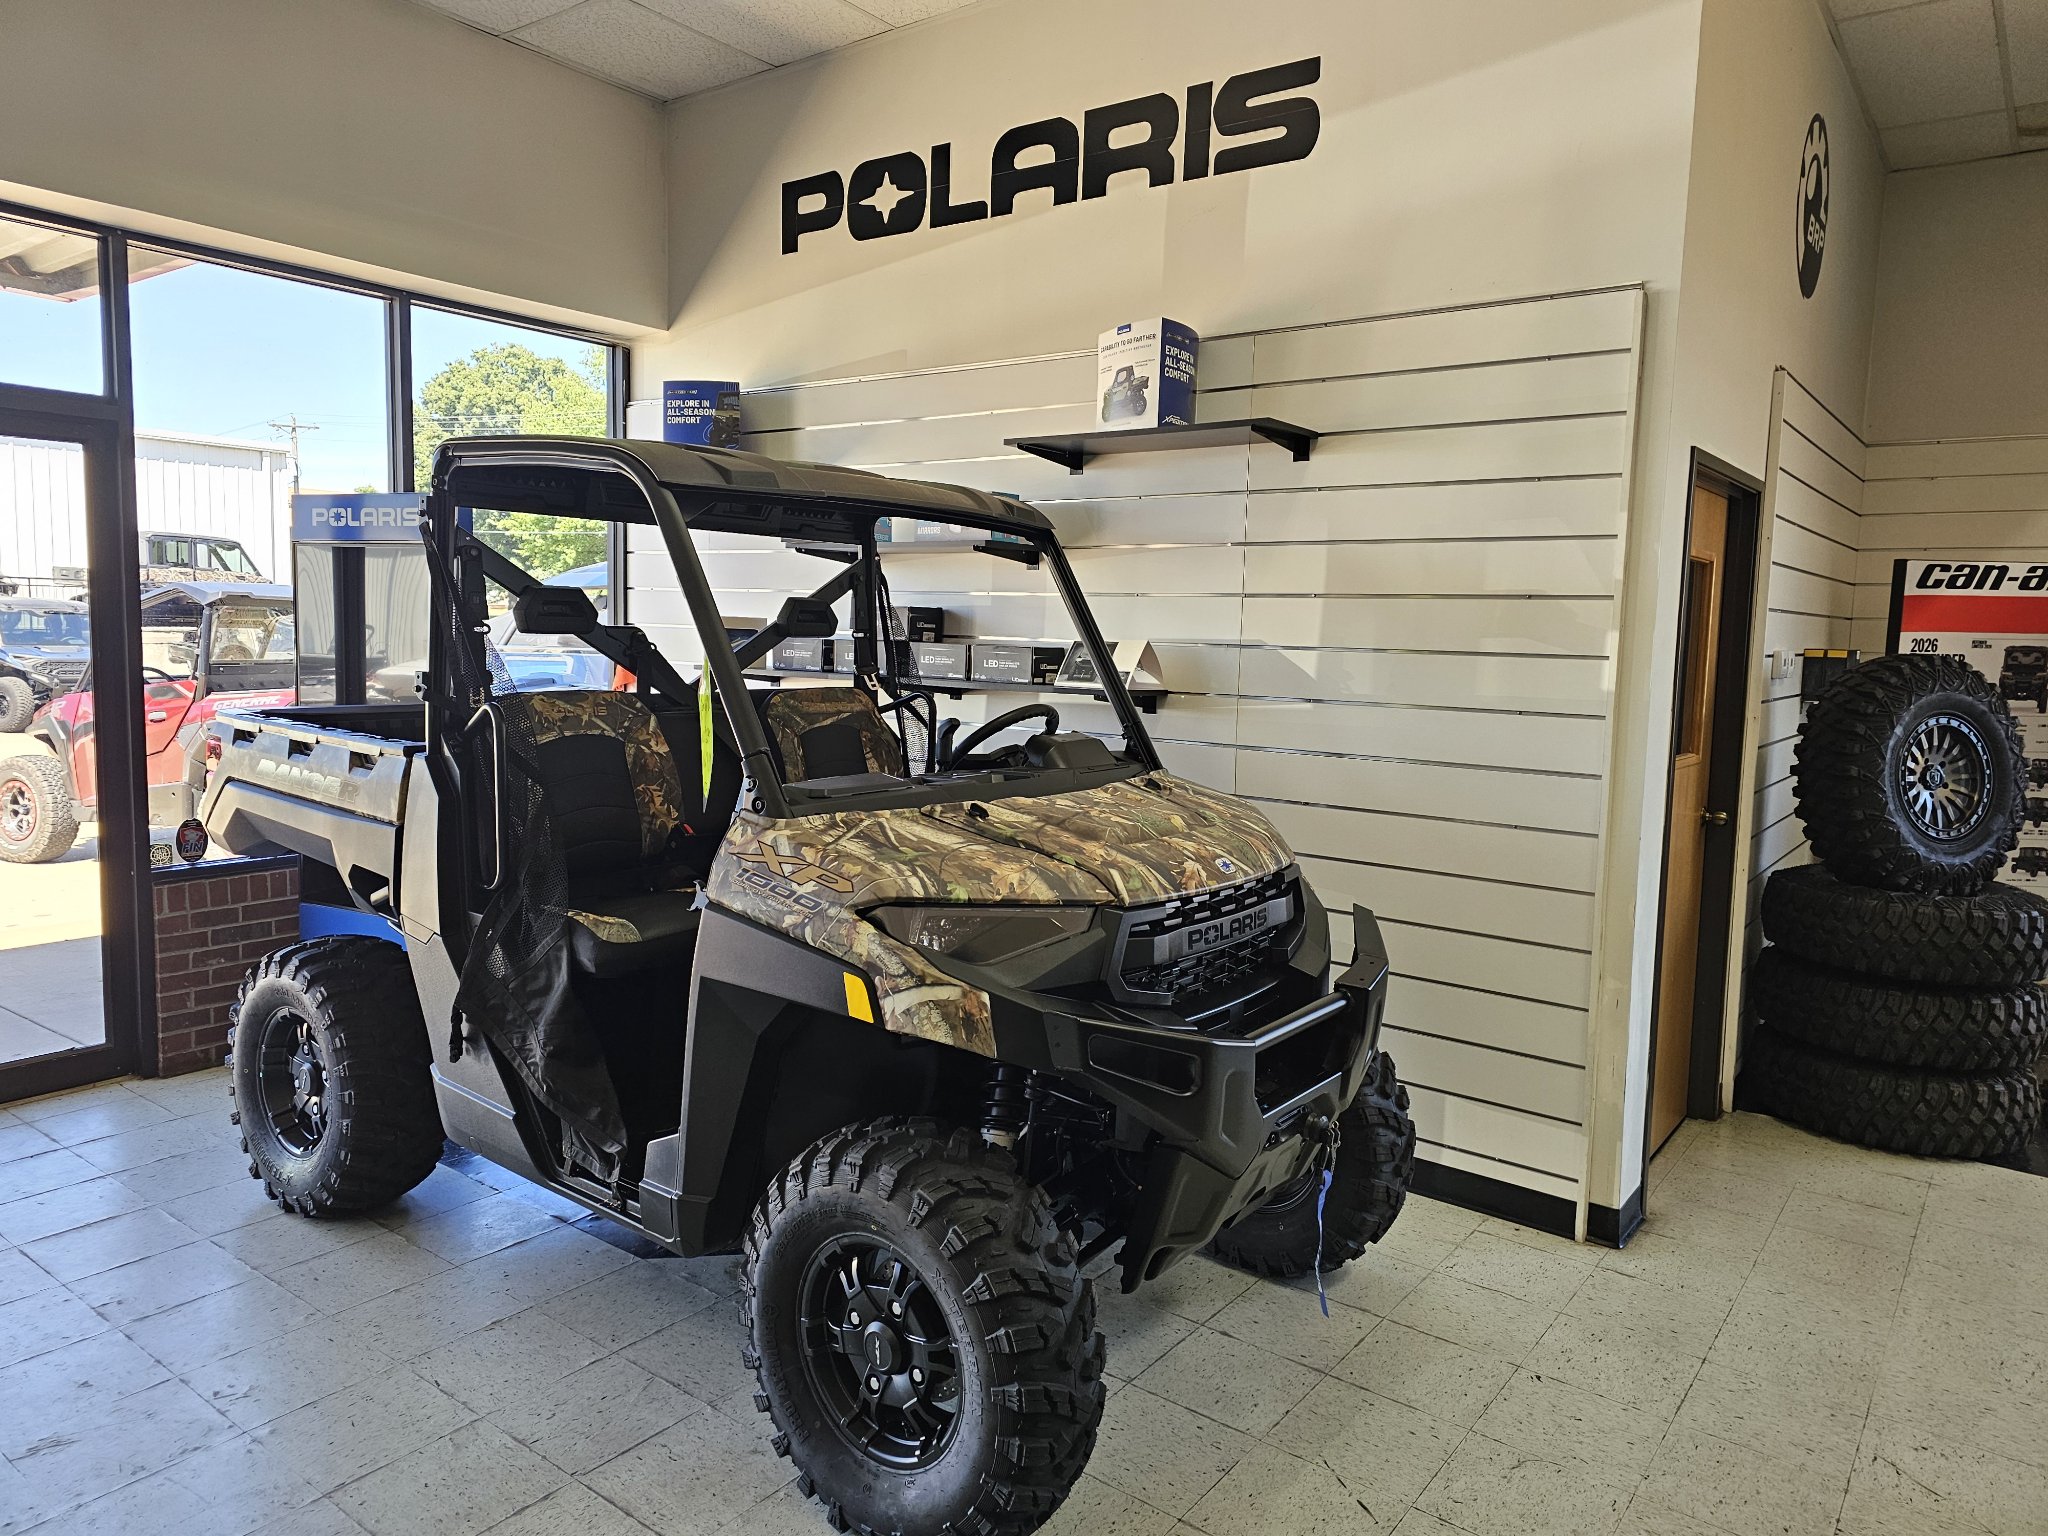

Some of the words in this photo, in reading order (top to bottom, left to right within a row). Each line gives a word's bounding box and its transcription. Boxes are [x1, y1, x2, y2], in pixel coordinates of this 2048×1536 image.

[781, 56, 1321, 255] POLARIS
[1807, 213, 1825, 254] BRP
[1133, 333, 1157, 343] FARTHER
[1165, 345, 1190, 362] EXPLORE
[1164, 367, 1190, 384] COMFORT
[666, 399, 700, 408] EXPLORE
[701, 399, 710, 408] IN
[666, 408, 716, 416] ALL-SEASON
[666, 416, 701, 424] COMFORT
[311, 507, 420, 527] POLARIS
[1915, 563, 2048, 591] can-a
[782, 649, 795, 657] LED
[1910, 638, 1939, 653] 2026
[845, 652, 854, 660] LE
[920, 655, 935, 664] LED
[983, 659, 999, 668] LED
[255, 758, 360, 804] RANGER
[728, 839, 855, 894] XP
[735, 867, 823, 914] 1000
[1187, 907, 1268, 951] POLARIS
